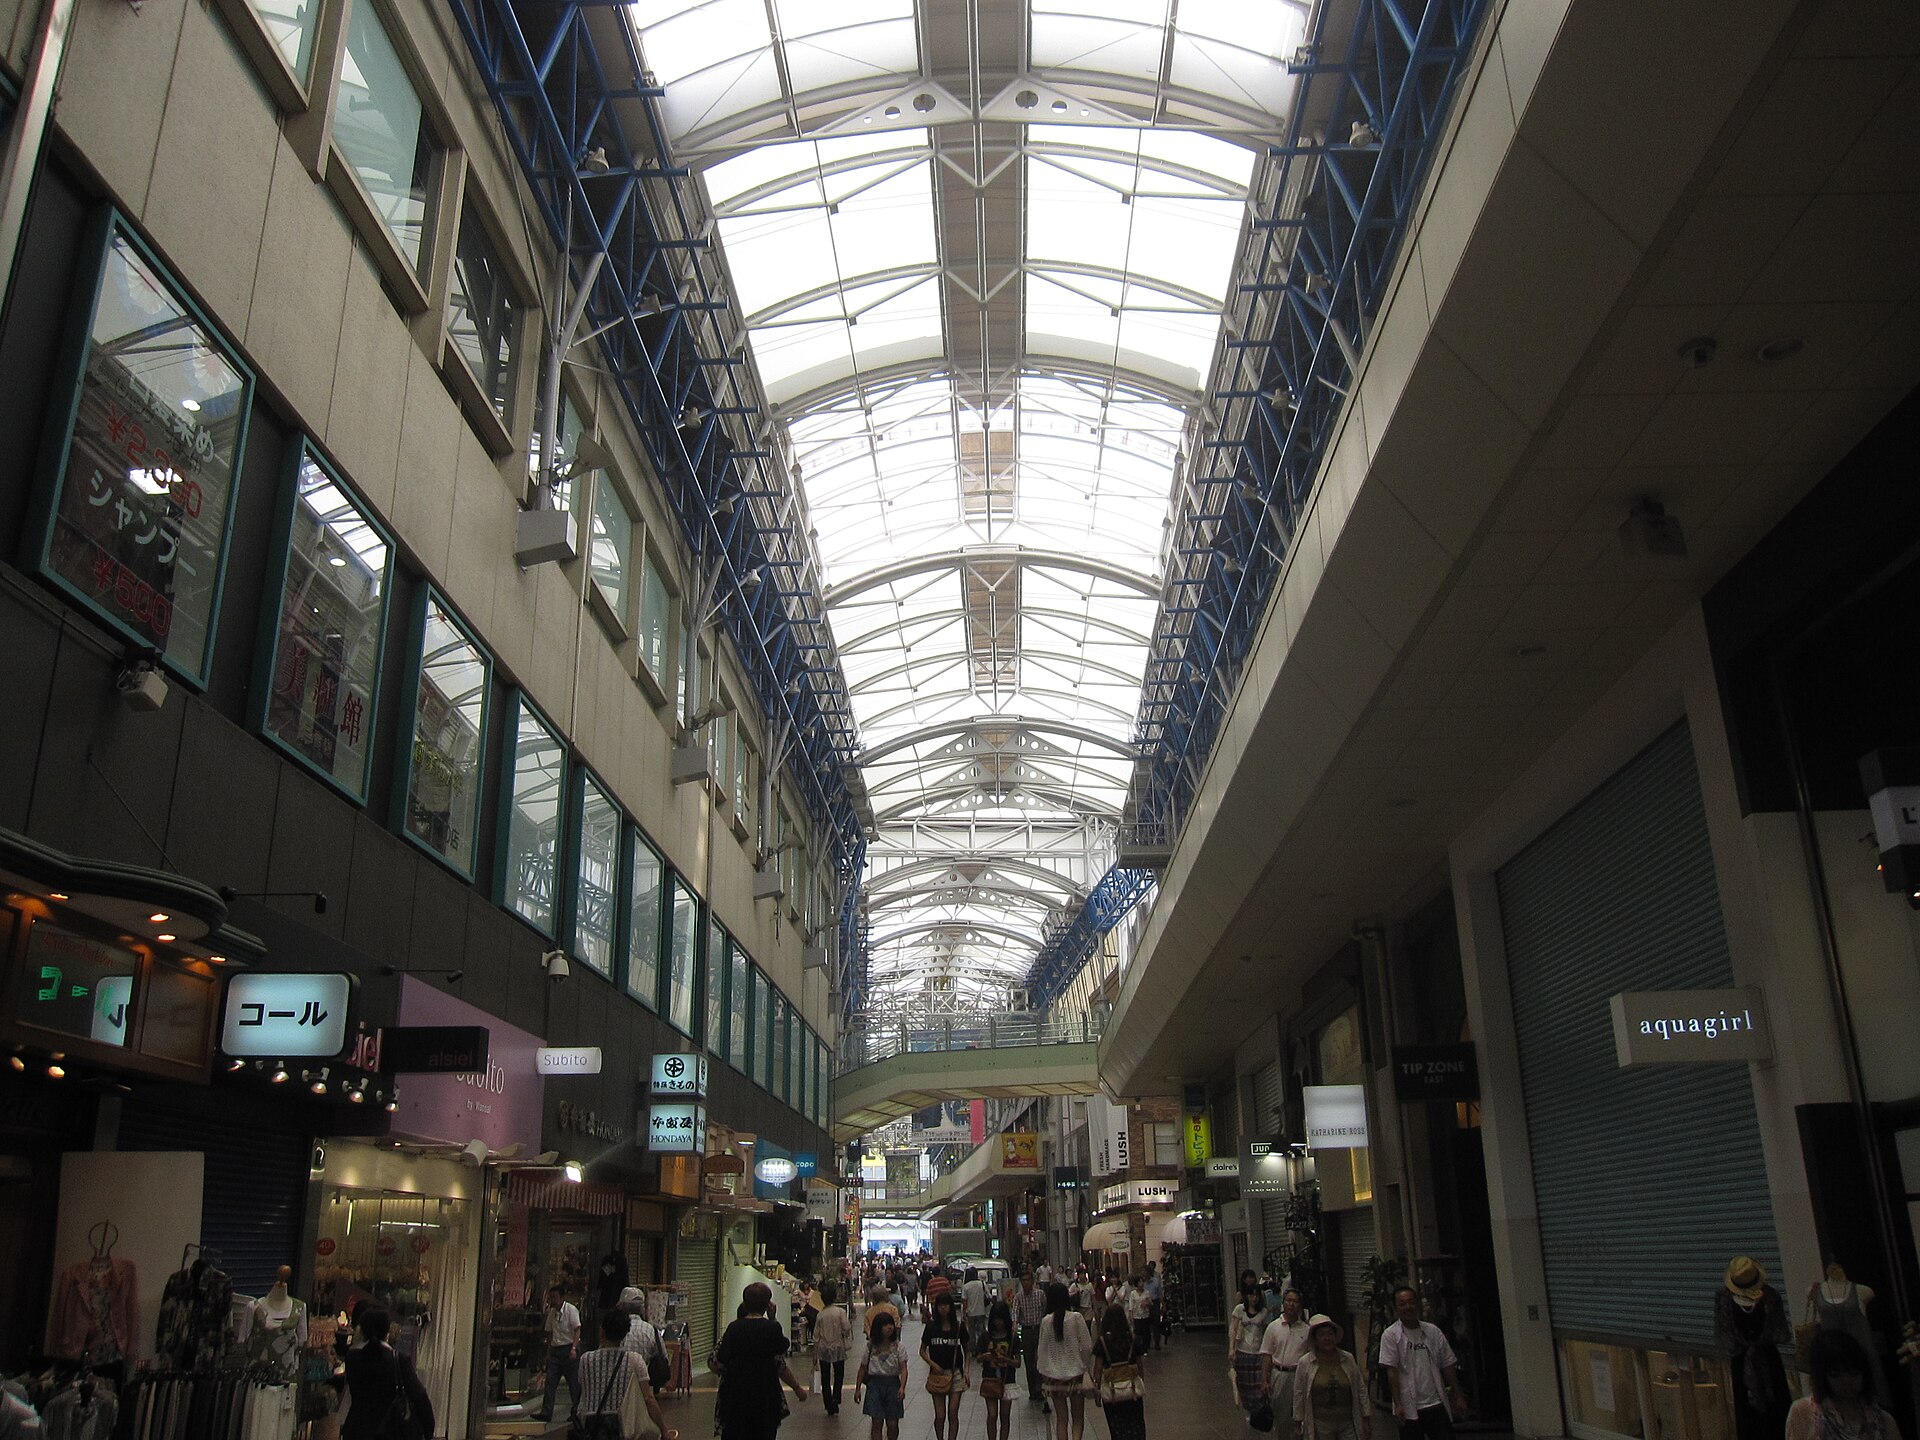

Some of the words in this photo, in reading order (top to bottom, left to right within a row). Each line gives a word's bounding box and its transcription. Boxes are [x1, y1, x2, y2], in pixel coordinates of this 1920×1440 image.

[89, 469, 197, 576] シャンプー
[93, 549, 172, 637] ¥500
[239, 1001, 328, 1027] コール
[1640, 1009, 1753, 1041] aquagirl
[428, 1050, 474, 1067] alsiel
[544, 1053, 588, 1066] Subito
[1401, 1063, 1423, 1075] TIP
[1426, 1061, 1465, 1074] ZONE
[650, 1134, 693, 1144] HONDAYA
[1118, 1131, 1128, 1166] LUSH
[1213, 1163, 1238, 1171] claire's
[1138, 1187, 1167, 1196] LUSH
